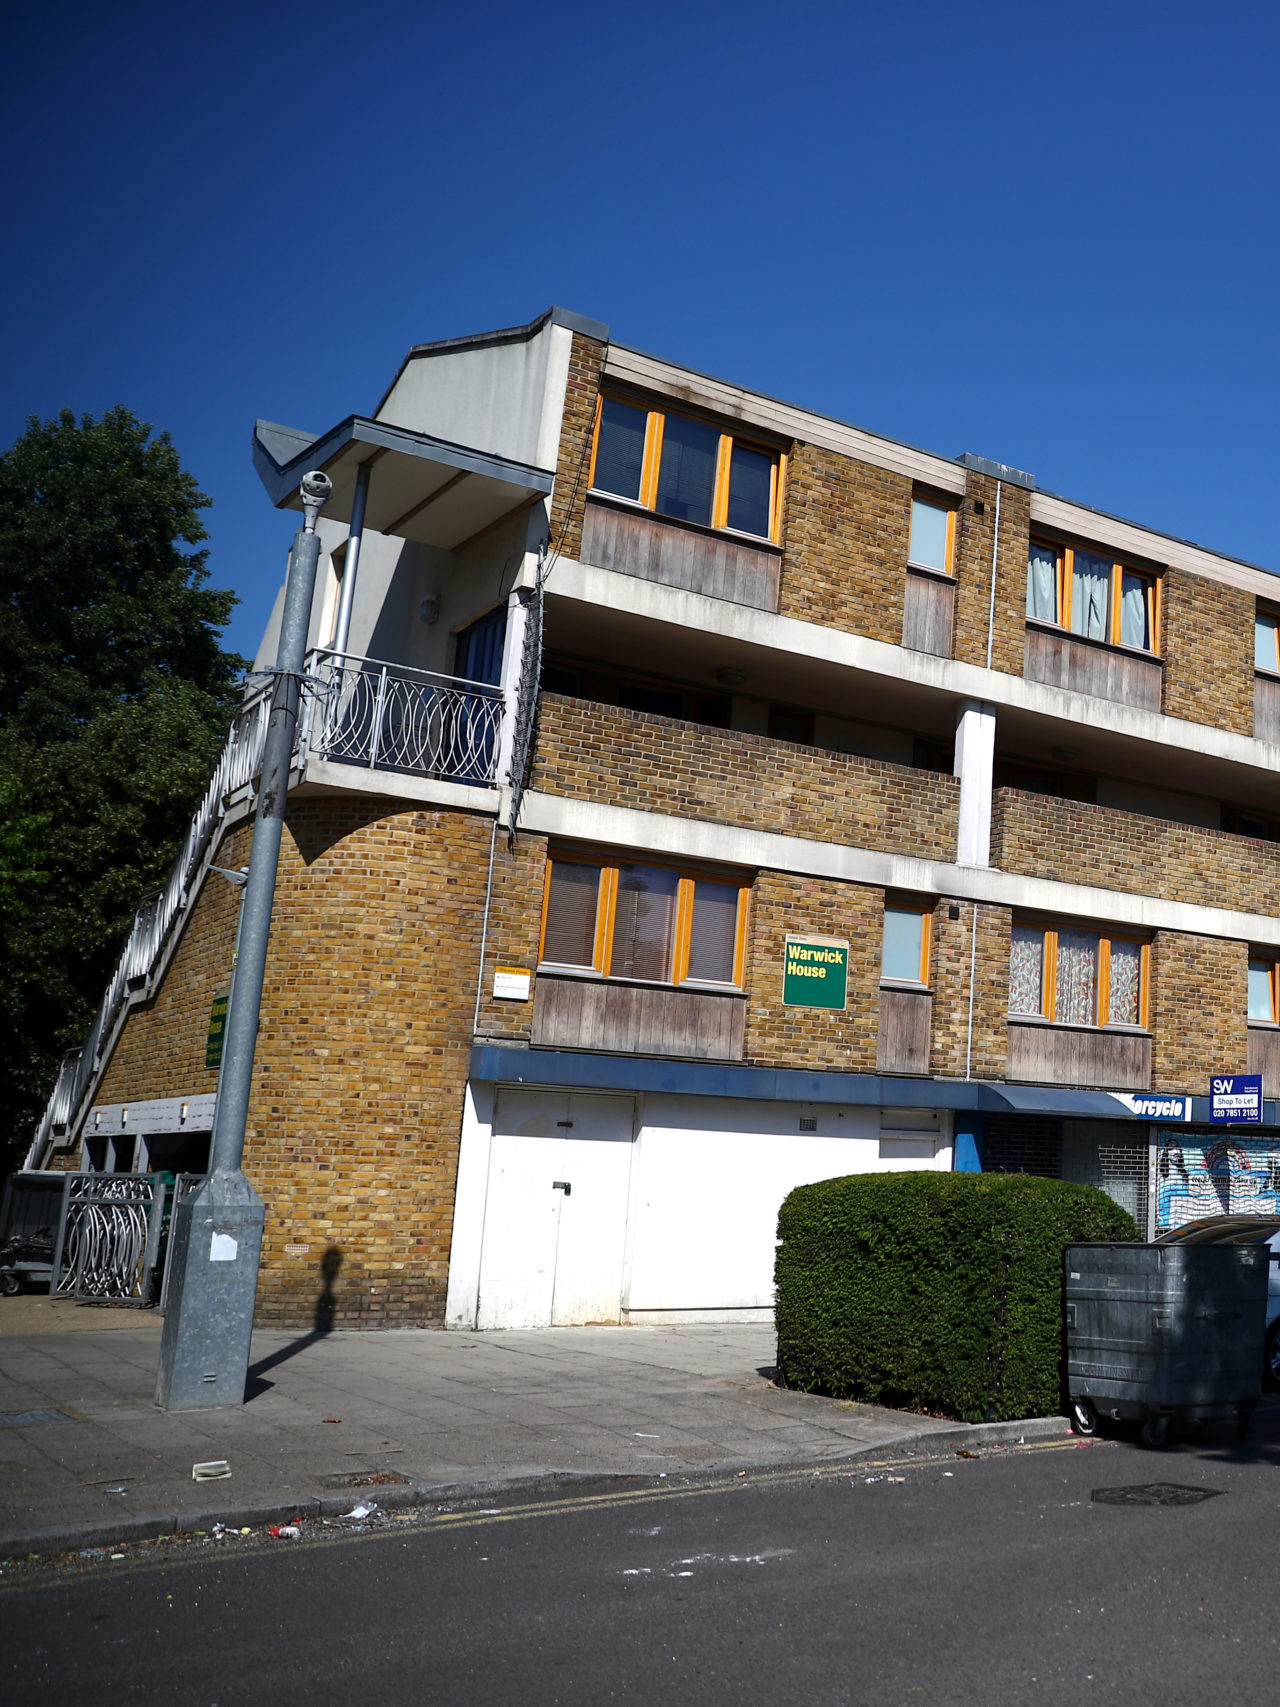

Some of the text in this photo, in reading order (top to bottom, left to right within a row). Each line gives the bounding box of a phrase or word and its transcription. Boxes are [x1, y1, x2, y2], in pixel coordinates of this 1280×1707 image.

[788, 945, 843, 964] Warwick
[787, 961, 826, 978] House
[1213, 1079, 1233, 1094] SW
[1217, 1097, 1254, 1106] Shop To Let
[1213, 1108, 1258, 1118] 020 7851 2100
